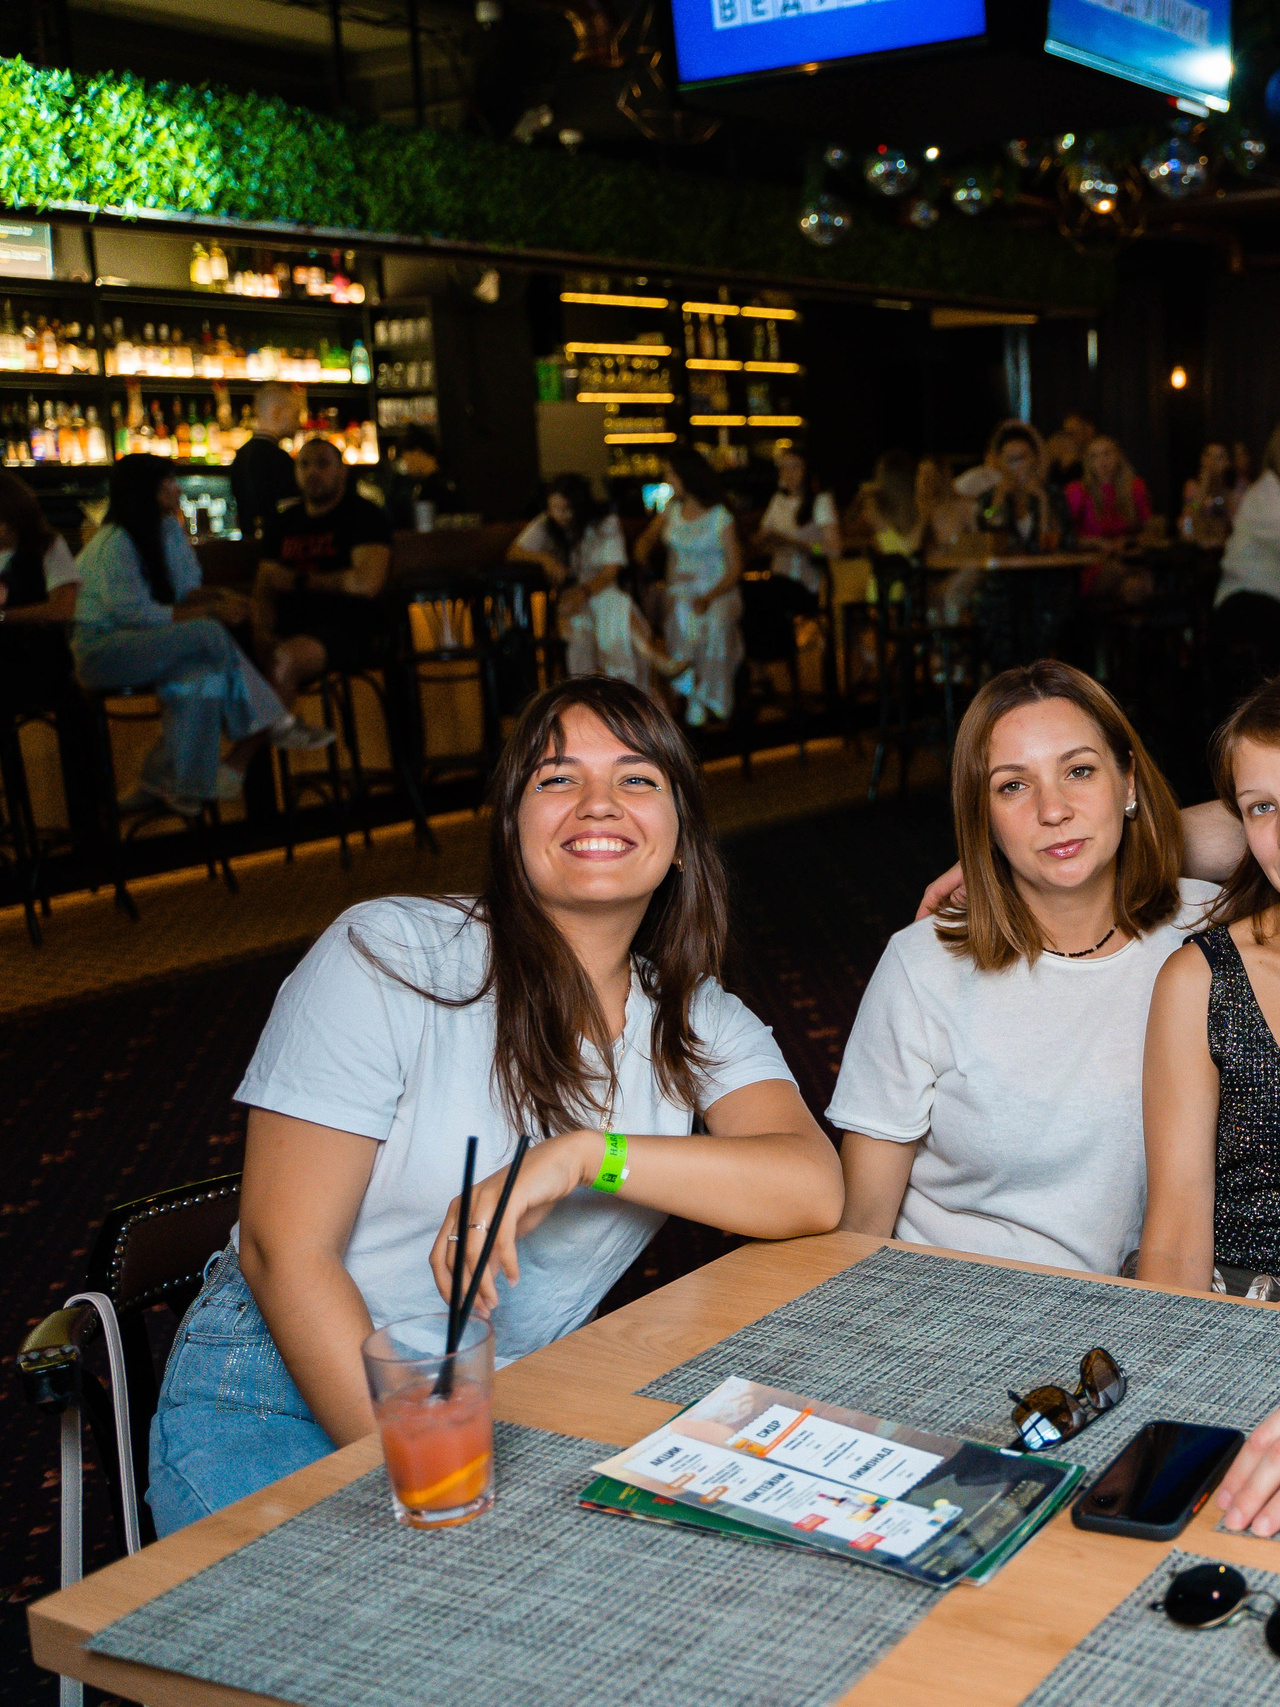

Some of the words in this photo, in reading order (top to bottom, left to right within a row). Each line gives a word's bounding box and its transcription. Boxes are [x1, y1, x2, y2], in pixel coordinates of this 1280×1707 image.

[756, 1420, 781, 1439] СИДР
[650, 1446, 684, 1467] АКЦИИ
[848, 1447, 895, 1481] ЛИМОНАД
[741, 1472, 789, 1503] КОКТЕЙЛИ
